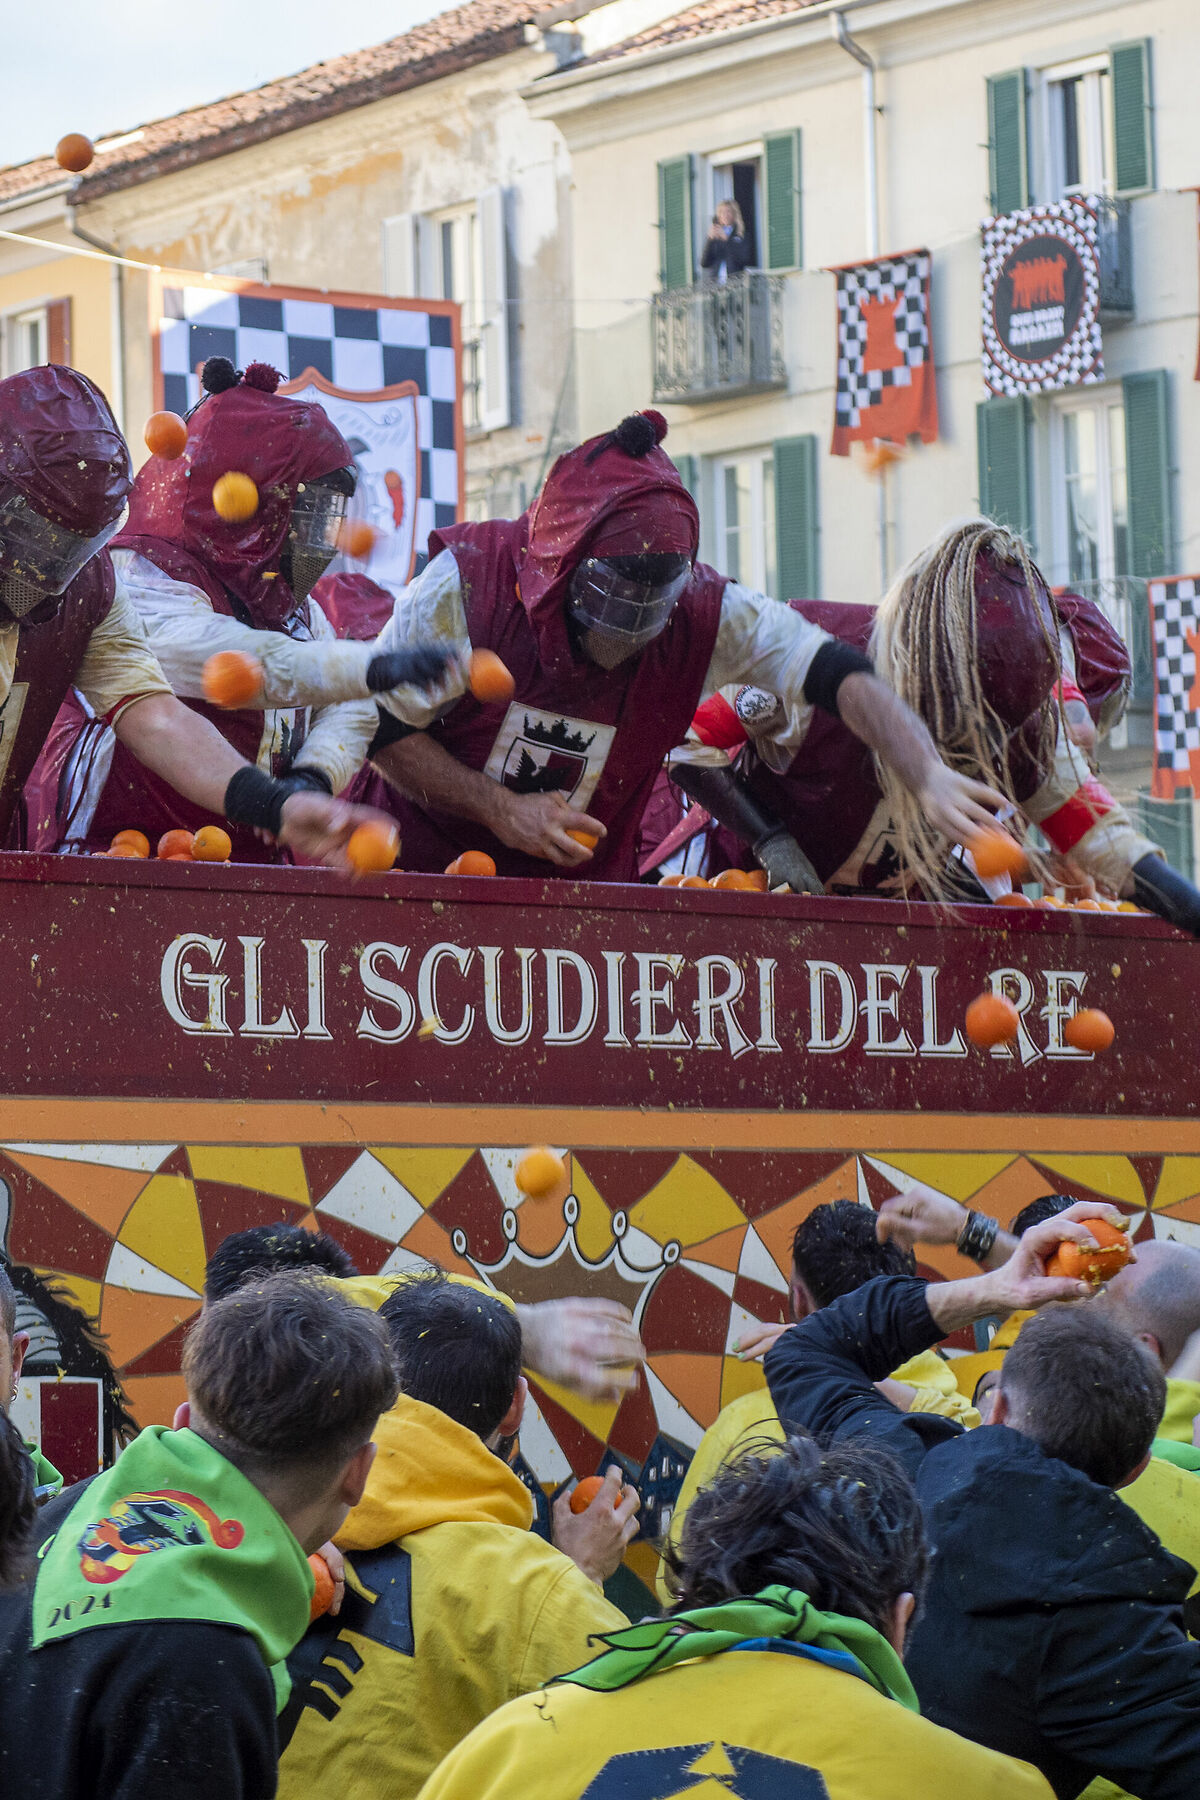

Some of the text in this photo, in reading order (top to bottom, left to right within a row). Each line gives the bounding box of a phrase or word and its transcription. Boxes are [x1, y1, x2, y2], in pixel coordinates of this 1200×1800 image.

[160, 932, 334, 1040] GLI
[355, 941, 782, 1060] SCUDIERI
[803, 959, 968, 1058] DEL
[47, 1590, 115, 1629] 2024
